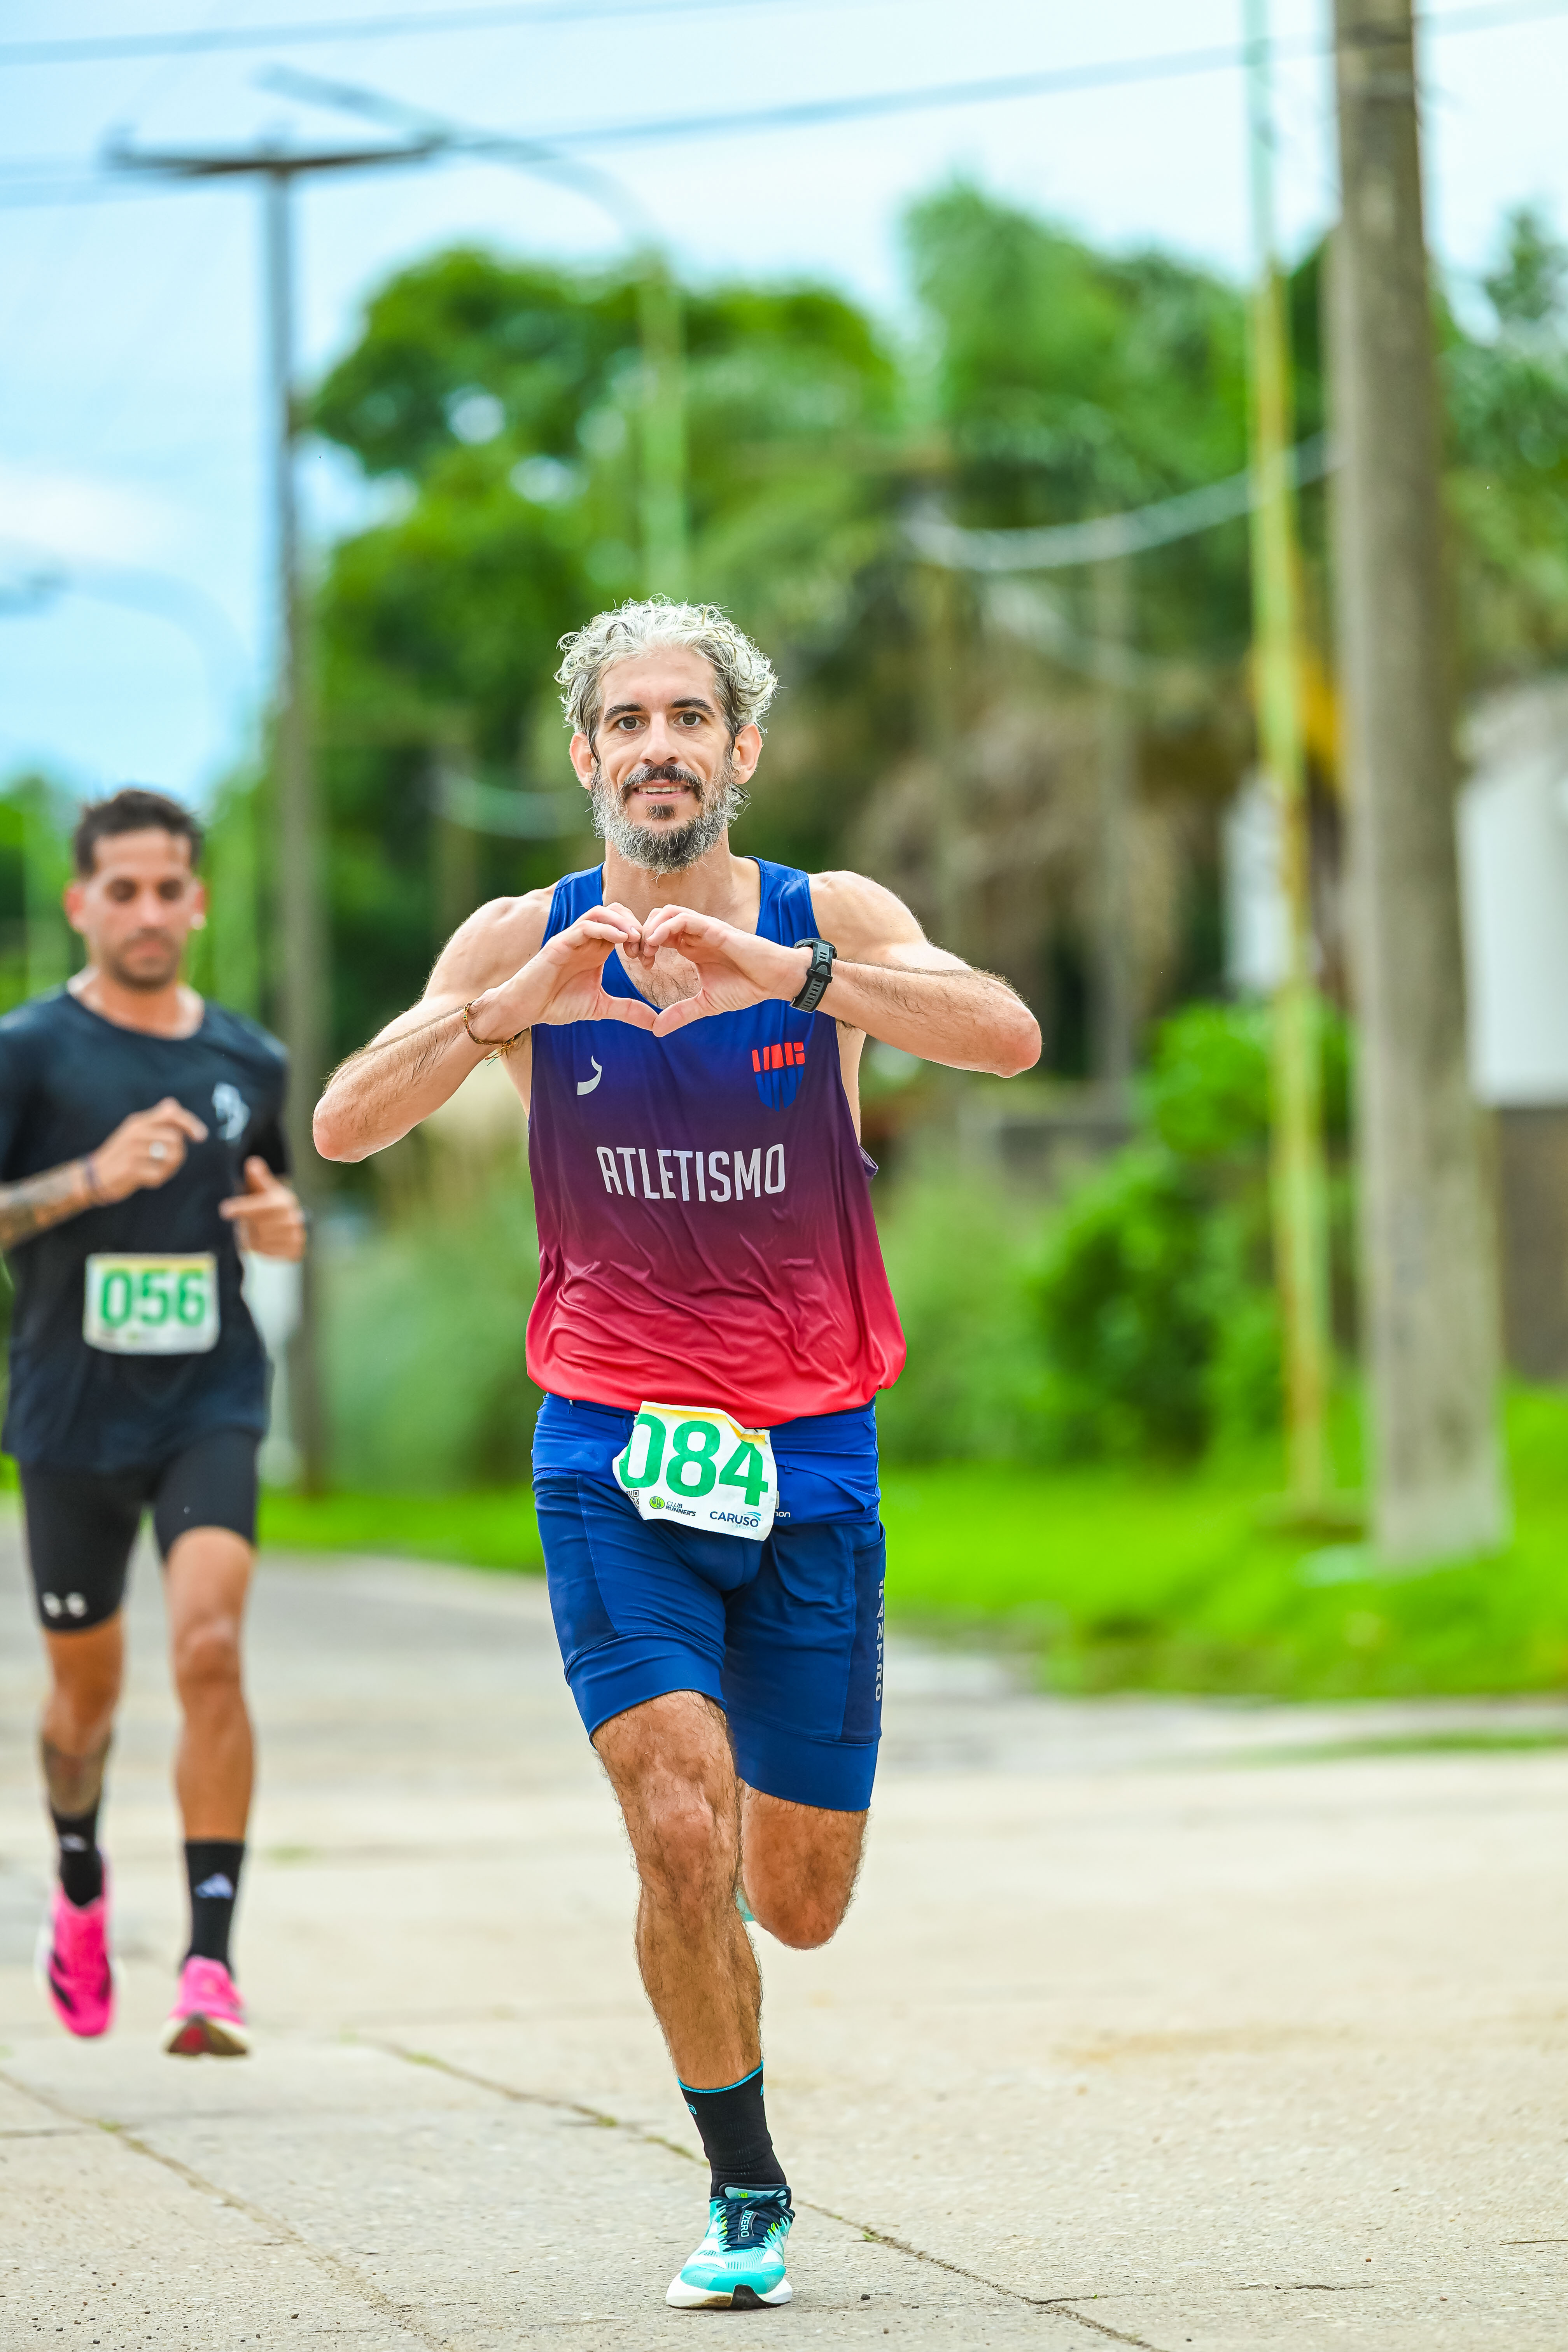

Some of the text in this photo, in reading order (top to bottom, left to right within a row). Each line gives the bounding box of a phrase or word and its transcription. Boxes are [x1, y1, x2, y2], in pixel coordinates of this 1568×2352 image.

[596, 1143, 786, 1202] ATLETISMO
[100, 1267, 206, 1328] 056
[619, 1414, 768, 1507] 084
[665, 1505, 696, 1516] RUNNER'S
[709, 1511, 759, 1528] CARUSO
[735, 1524, 758, 1532] SEGUROS
[740, 2210, 754, 2238] DIZERO
